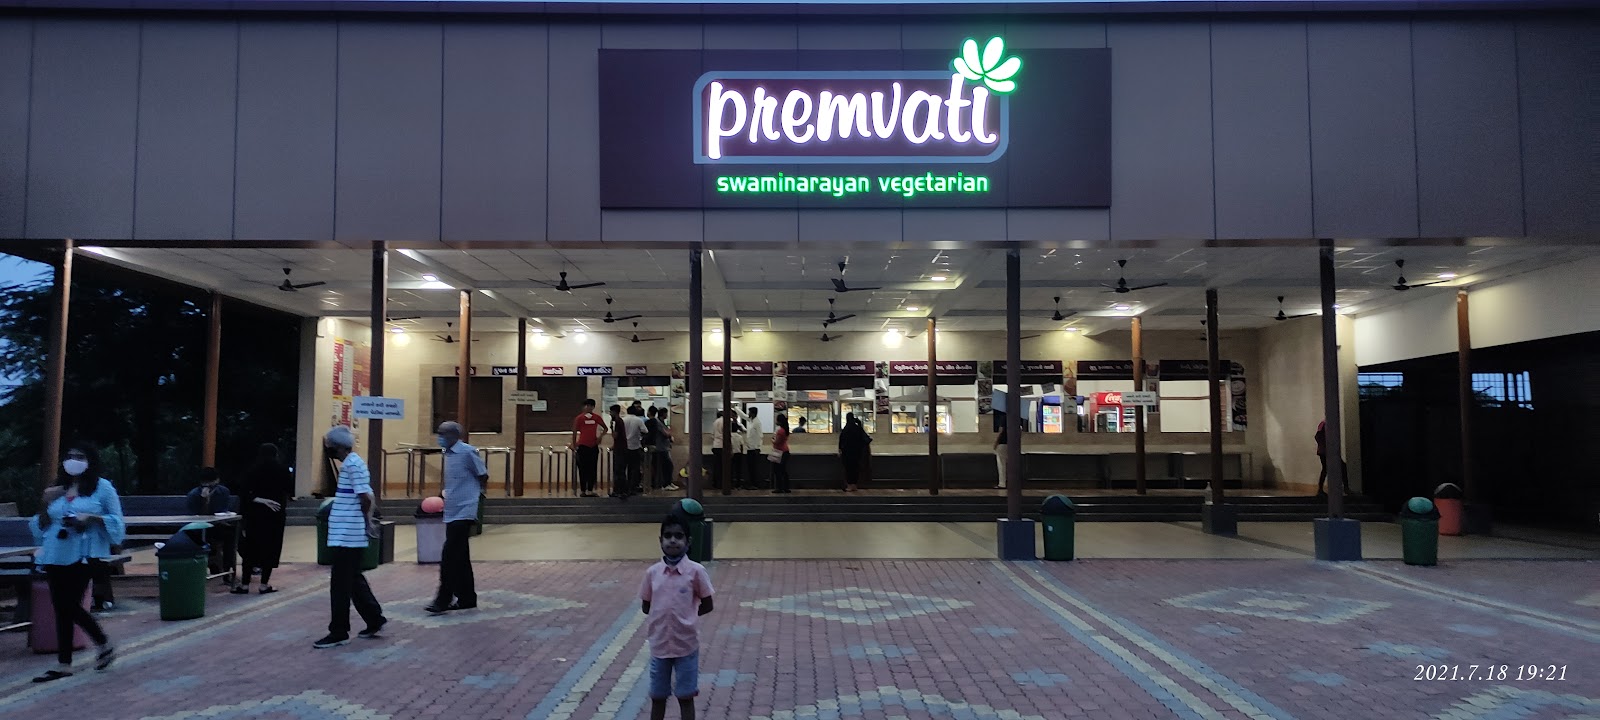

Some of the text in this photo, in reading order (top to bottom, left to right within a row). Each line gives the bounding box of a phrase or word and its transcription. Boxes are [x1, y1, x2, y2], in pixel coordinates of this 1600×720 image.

[707, 73, 998, 160] premvati
[717, 171, 989, 197] swaminarayan vegetarian
